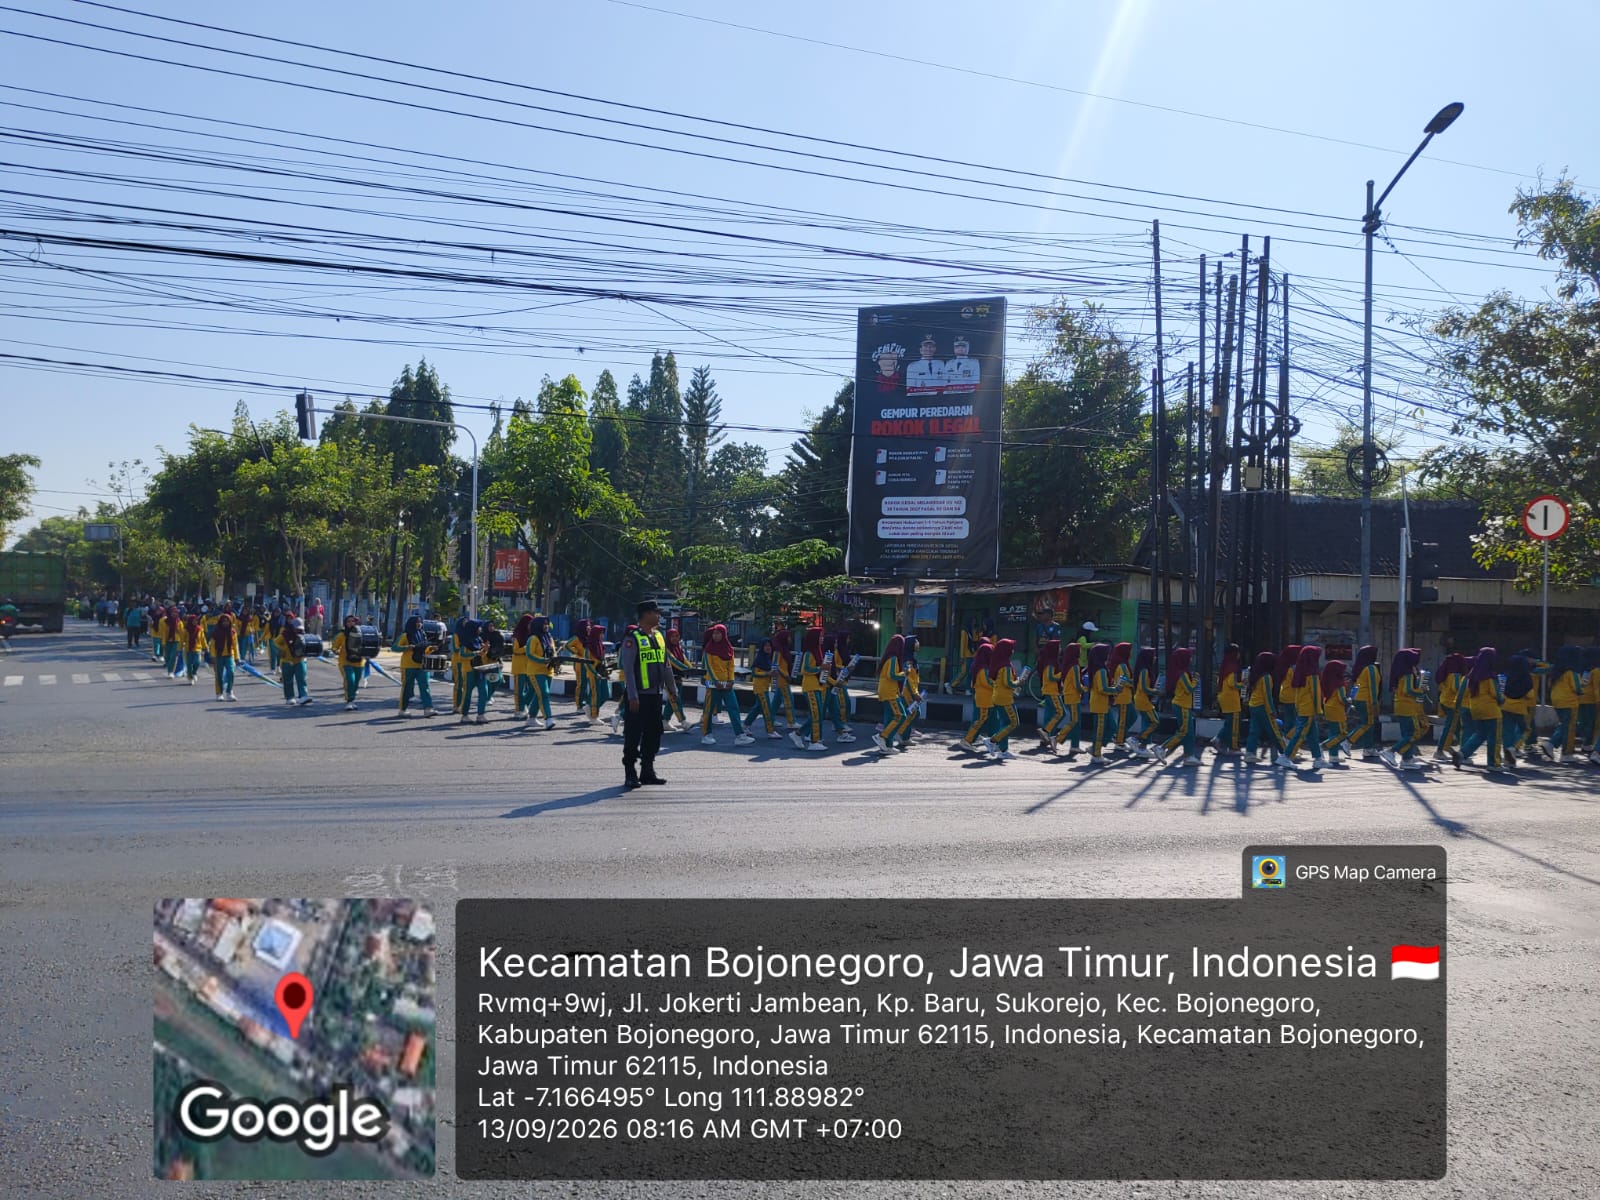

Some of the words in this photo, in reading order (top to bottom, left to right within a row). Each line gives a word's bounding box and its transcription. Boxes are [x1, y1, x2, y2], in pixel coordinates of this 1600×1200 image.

[881, 407, 917, 419] GEMPUR
[920, 405, 973, 417] PEREDARAN
[872, 420, 925, 436] ROKOK
[929, 417, 981, 435] ILEGAL
